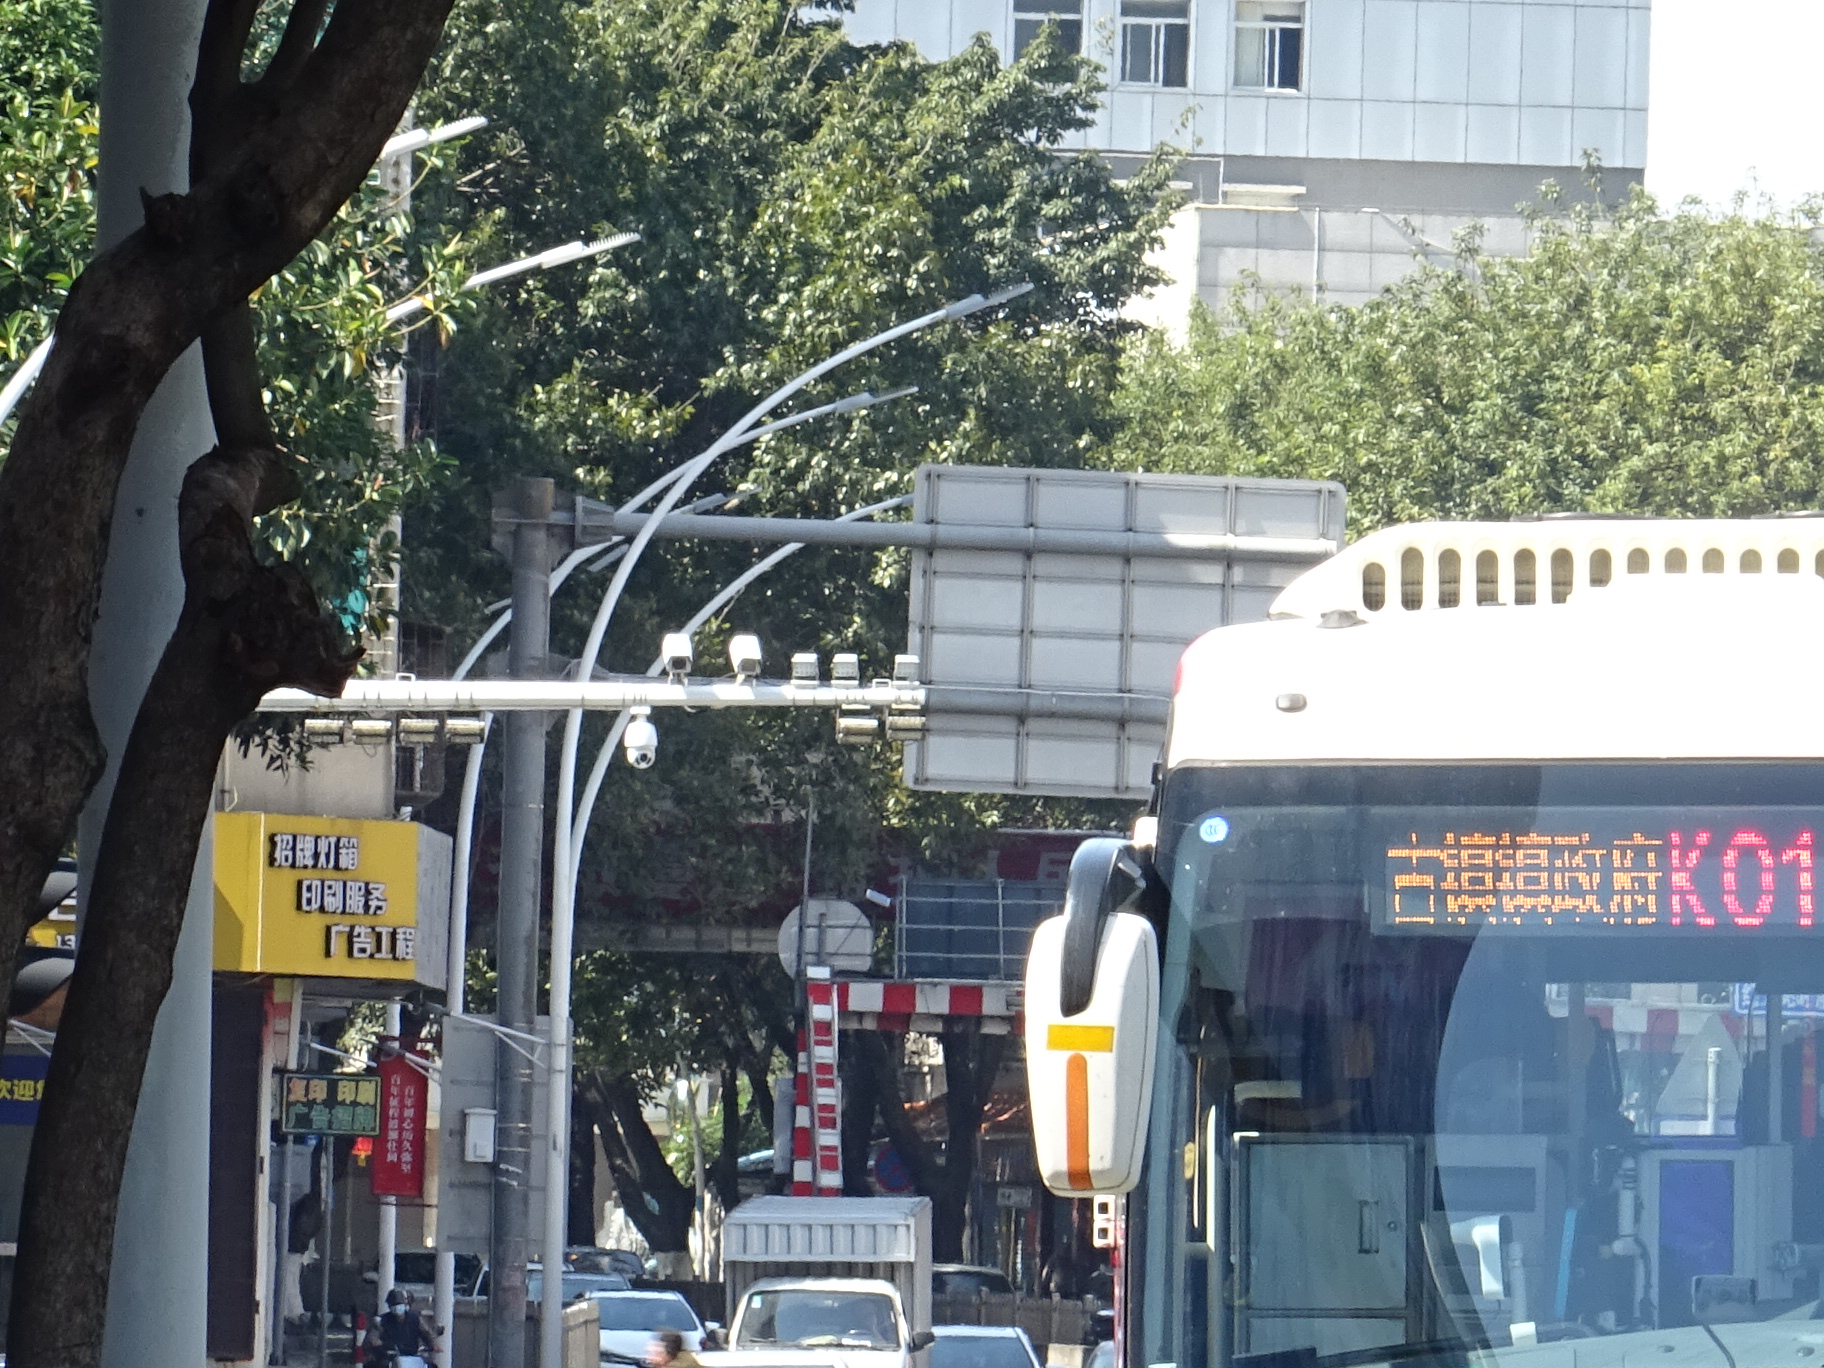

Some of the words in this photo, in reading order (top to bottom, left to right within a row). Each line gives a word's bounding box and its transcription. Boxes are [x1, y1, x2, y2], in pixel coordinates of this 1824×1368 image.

[272, 833, 359, 870] 招牌灯箱
[300, 879, 388, 915] 印刷服务
[1669, 830, 1816, 927] K01
[329, 923, 417, 960] 广告工程
